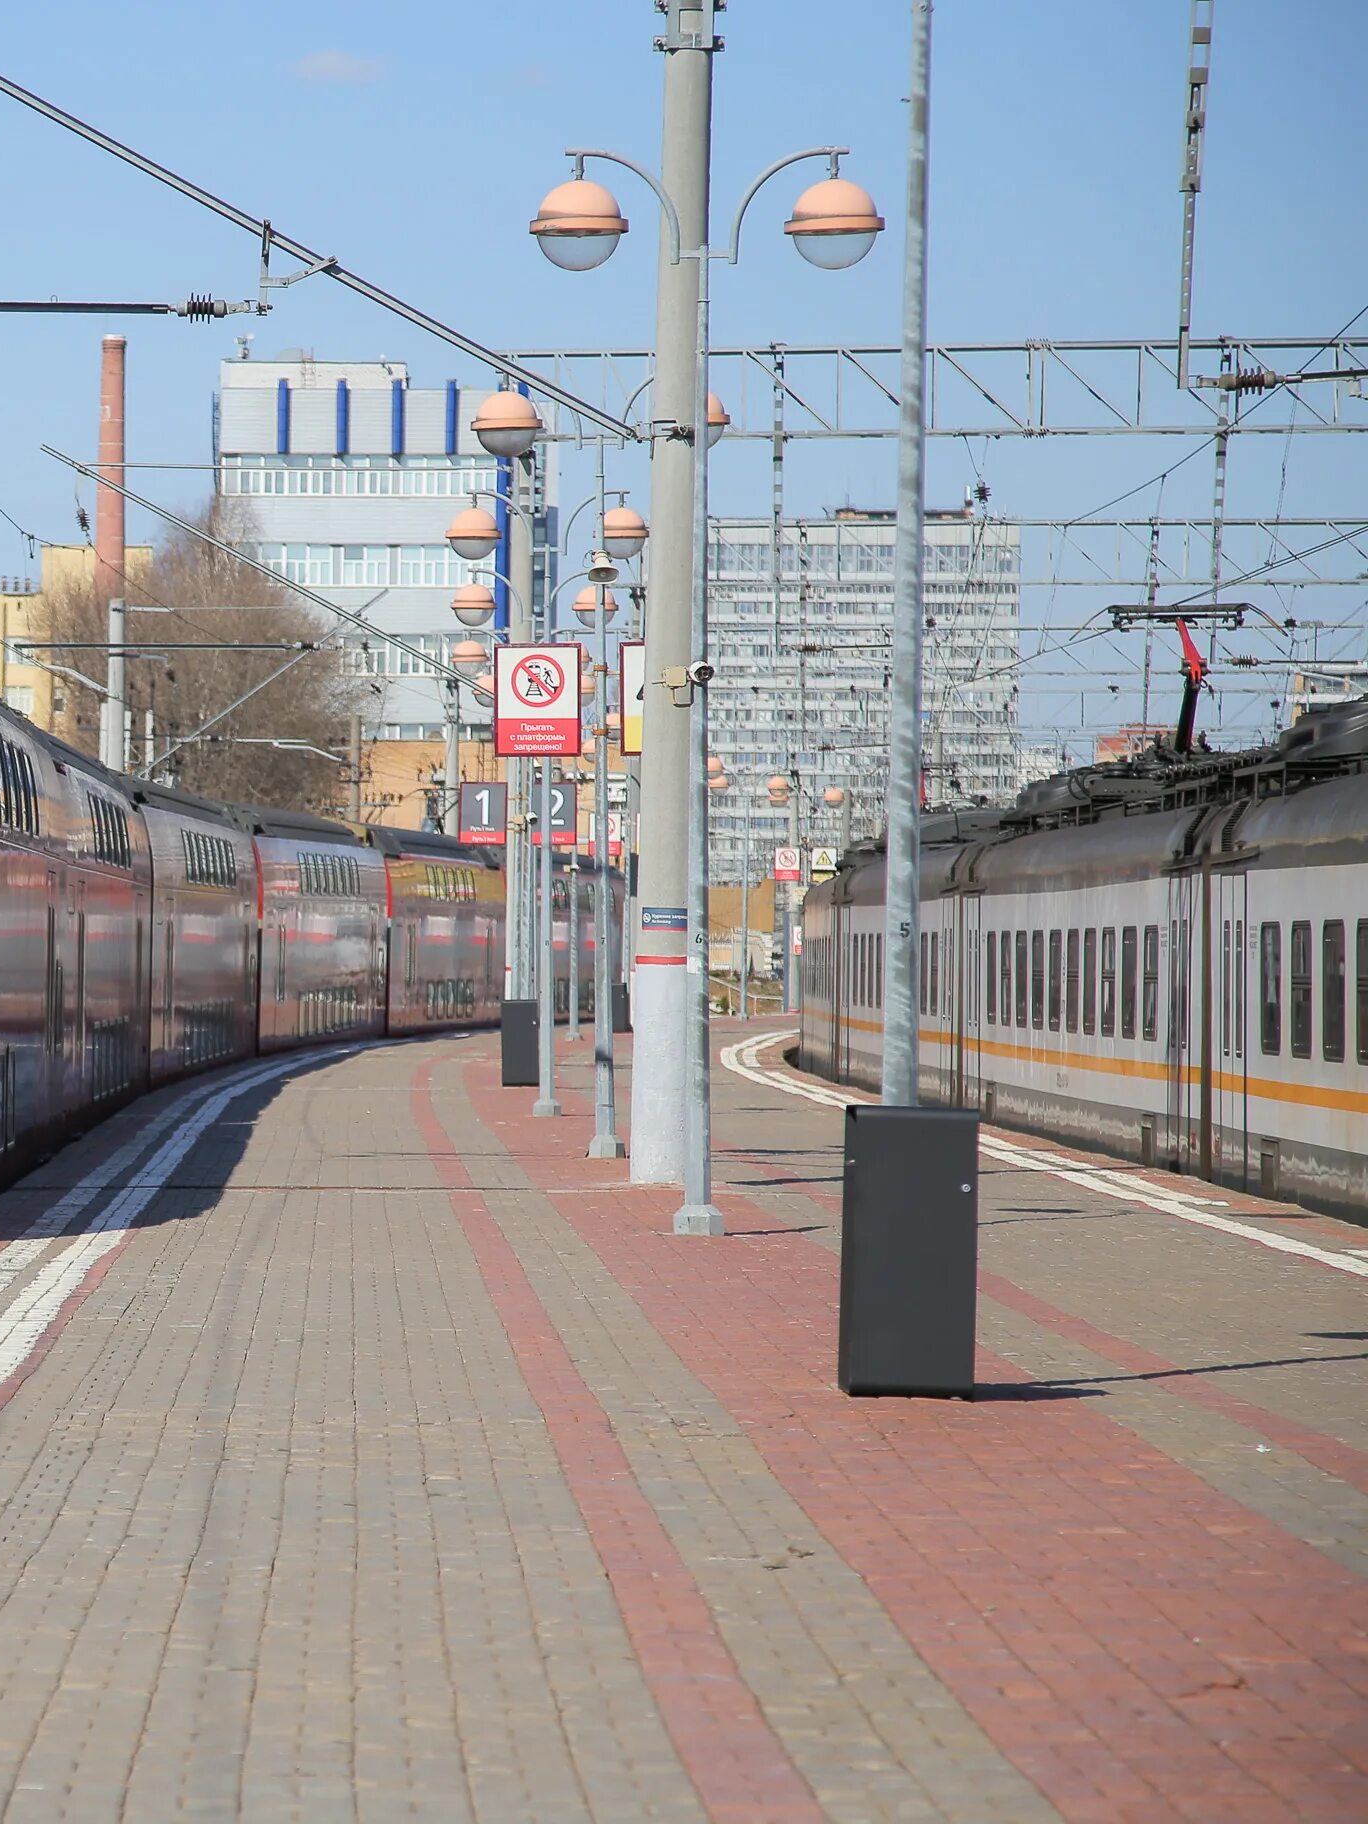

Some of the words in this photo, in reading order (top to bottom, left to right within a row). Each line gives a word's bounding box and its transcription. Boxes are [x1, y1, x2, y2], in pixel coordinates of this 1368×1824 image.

[520, 723, 556, 732] Прыгать
[517, 733, 566, 742] платформы
[513, 743, 563, 752] запрещено!
[474, 788, 490, 826] 1
[550, 788, 565, 826] 2
[899, 922, 910, 938] 5
[600, 937, 606, 945] 7
[695, 933, 703, 944] 6
